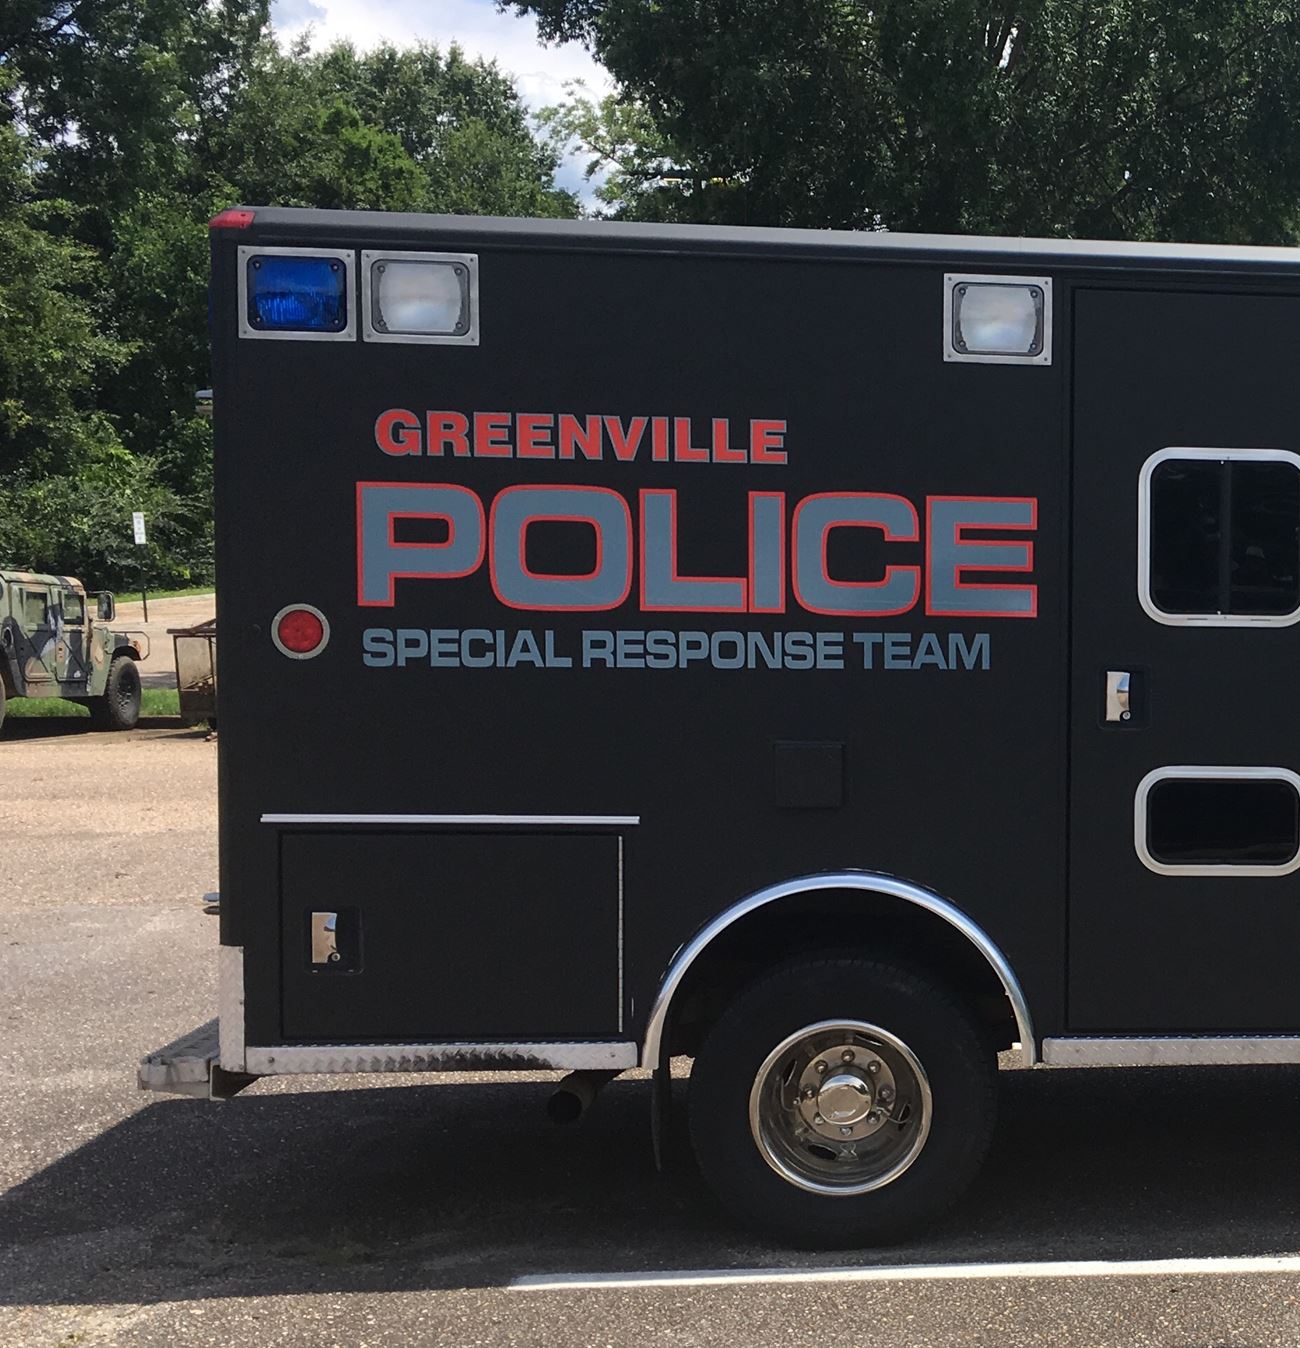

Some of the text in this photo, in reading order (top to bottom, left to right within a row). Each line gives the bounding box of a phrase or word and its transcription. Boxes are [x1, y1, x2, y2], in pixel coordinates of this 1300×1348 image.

[374, 408, 788, 465] GREENVILLE
[356, 481, 1038, 618] POLICE
[362, 627, 991, 670] SPECIAL RESPONSE TEAM
